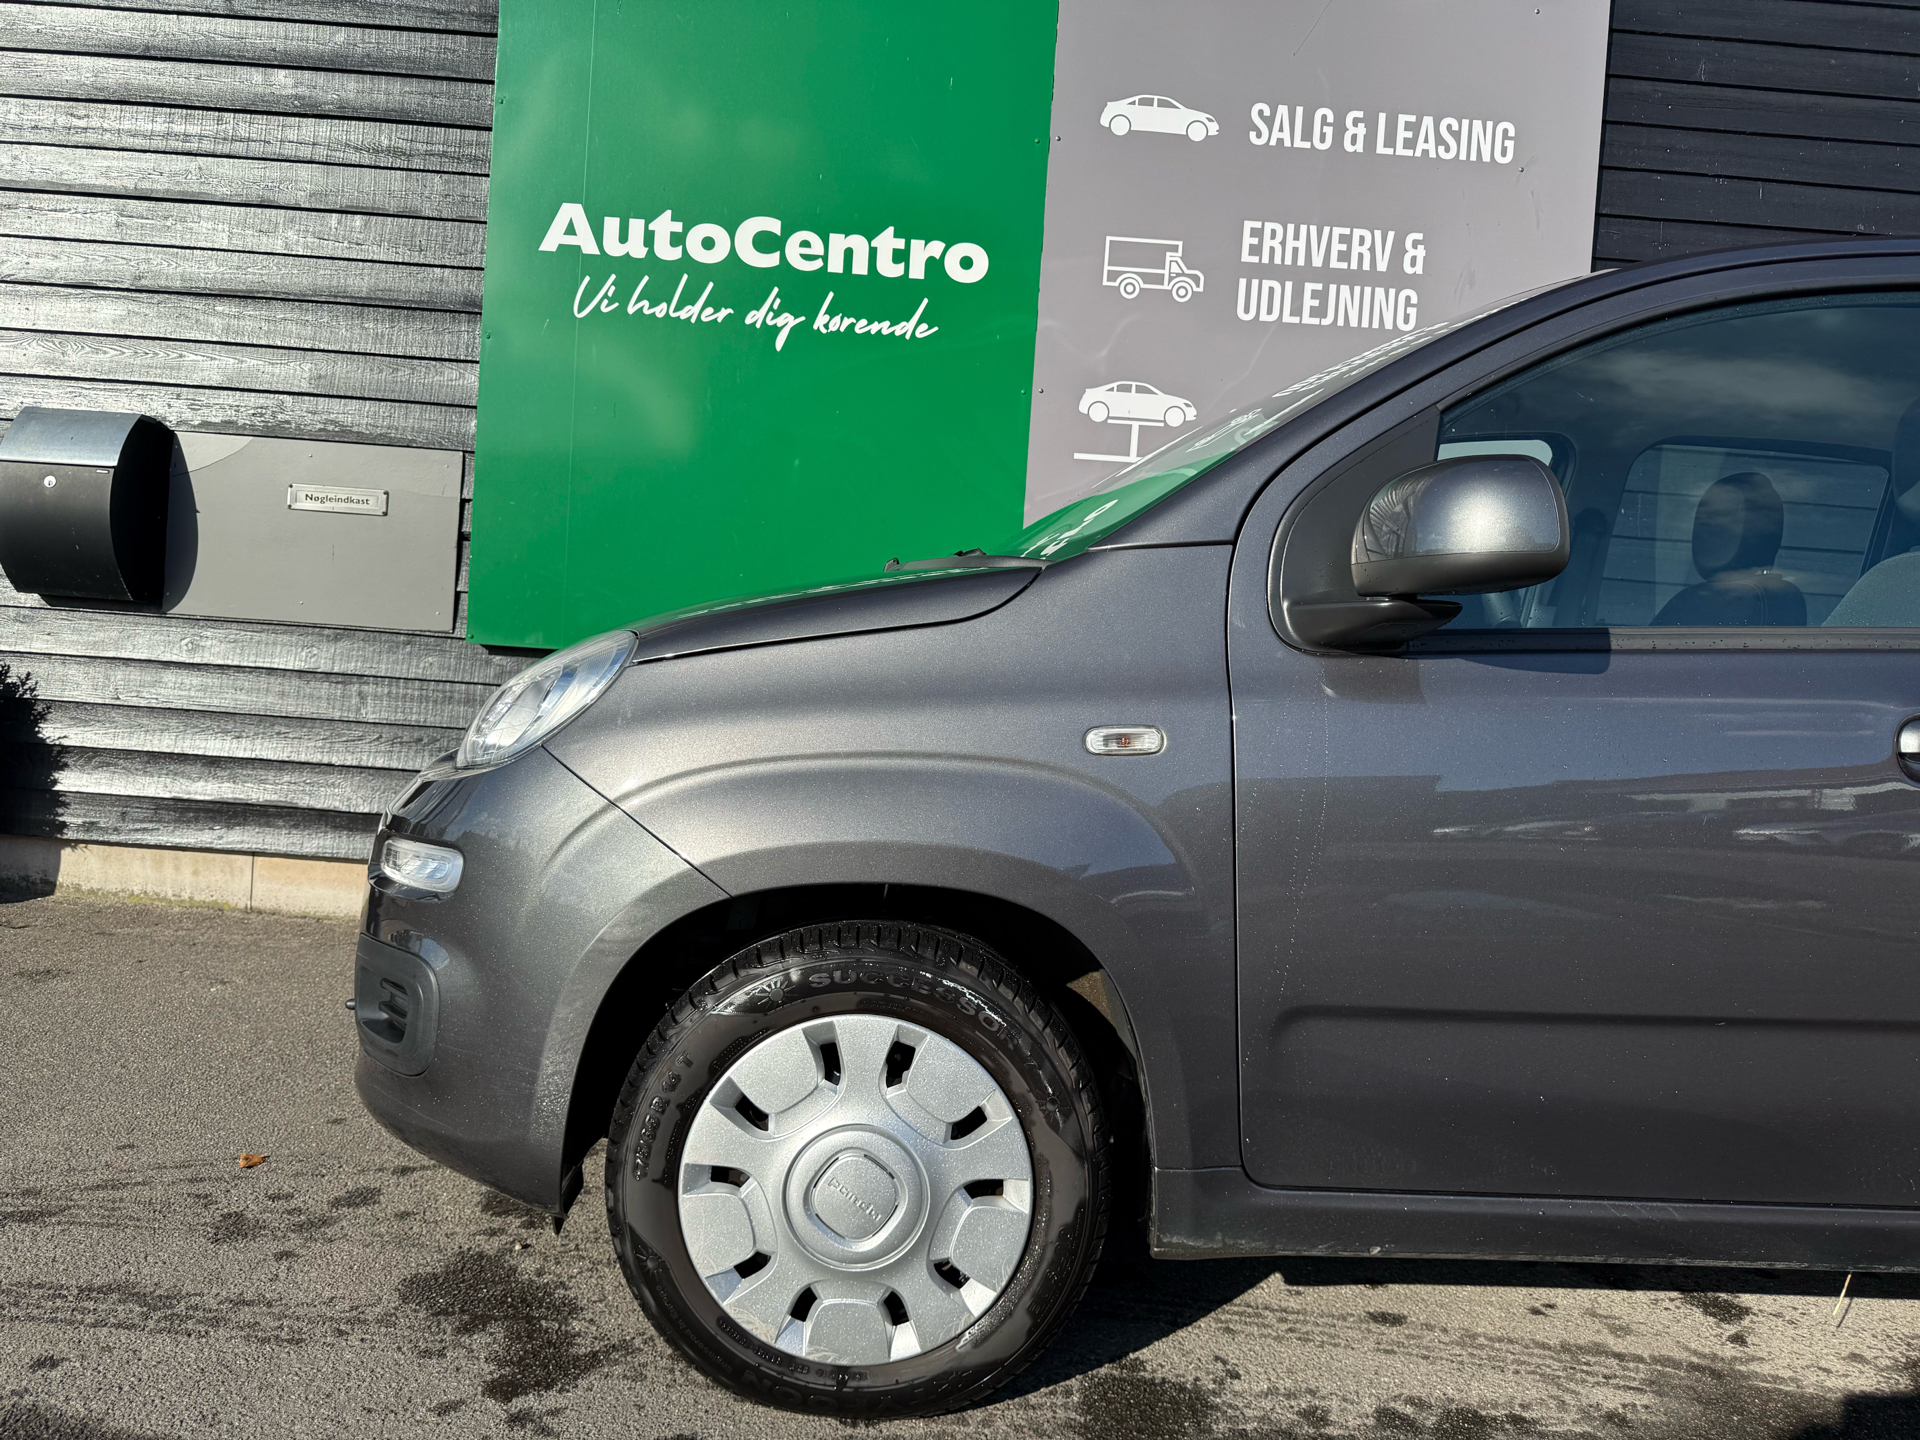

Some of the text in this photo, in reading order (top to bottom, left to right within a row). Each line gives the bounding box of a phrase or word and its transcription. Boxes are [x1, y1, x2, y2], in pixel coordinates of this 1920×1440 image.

[1249, 102, 1516, 164] SALG & LEASING
[538, 202, 990, 284] AutoCentro
[1240, 220, 1427, 275] ERHVERV &
[573, 273, 939, 352] Vi holder dig kørende
[1236, 277, 1418, 332] UDLEJNING
[305, 493, 370, 505] Nøgleindkast
[808, 968, 1018, 1050] SUCCESSOR
